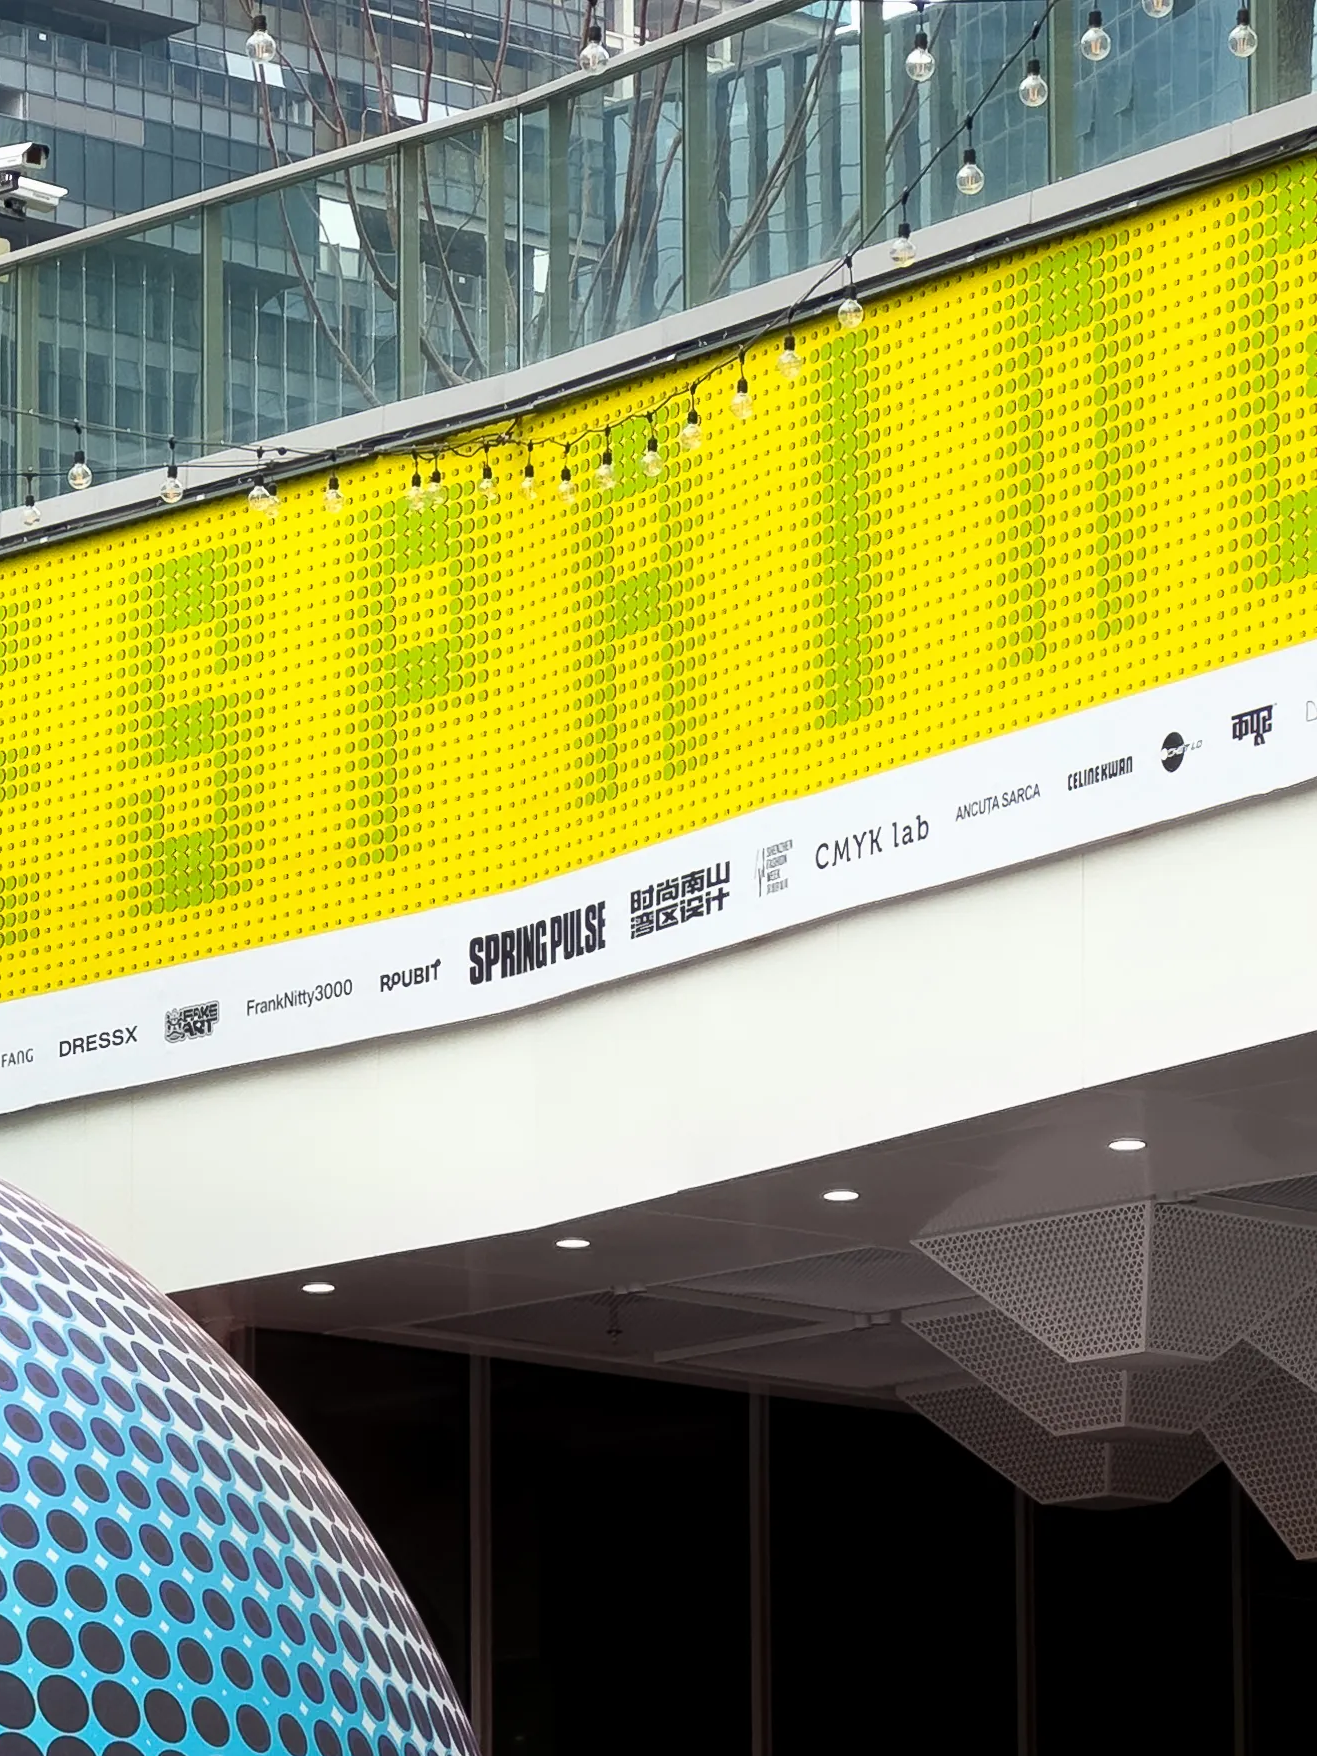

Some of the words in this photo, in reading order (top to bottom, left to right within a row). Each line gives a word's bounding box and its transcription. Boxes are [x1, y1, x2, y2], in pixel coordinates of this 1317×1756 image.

[1001, 782, 1041, 808] SARCA
[814, 825, 883, 870] CMYK
[891, 814, 930, 849] lab
[630, 860, 731, 914] 时尚南山
[630, 887, 731, 940] 湾区设计
[469, 918, 548, 986] SPRING
[549, 900, 606, 965] PULSE
[183, 1003, 218, 1022] FAKE
[246, 978, 353, 1016] FrankNitty3000
[58, 1025, 138, 1058] DRESSX
[182, 1017, 218, 1036] ART
[1, 1047, 34, 1069] FANG
